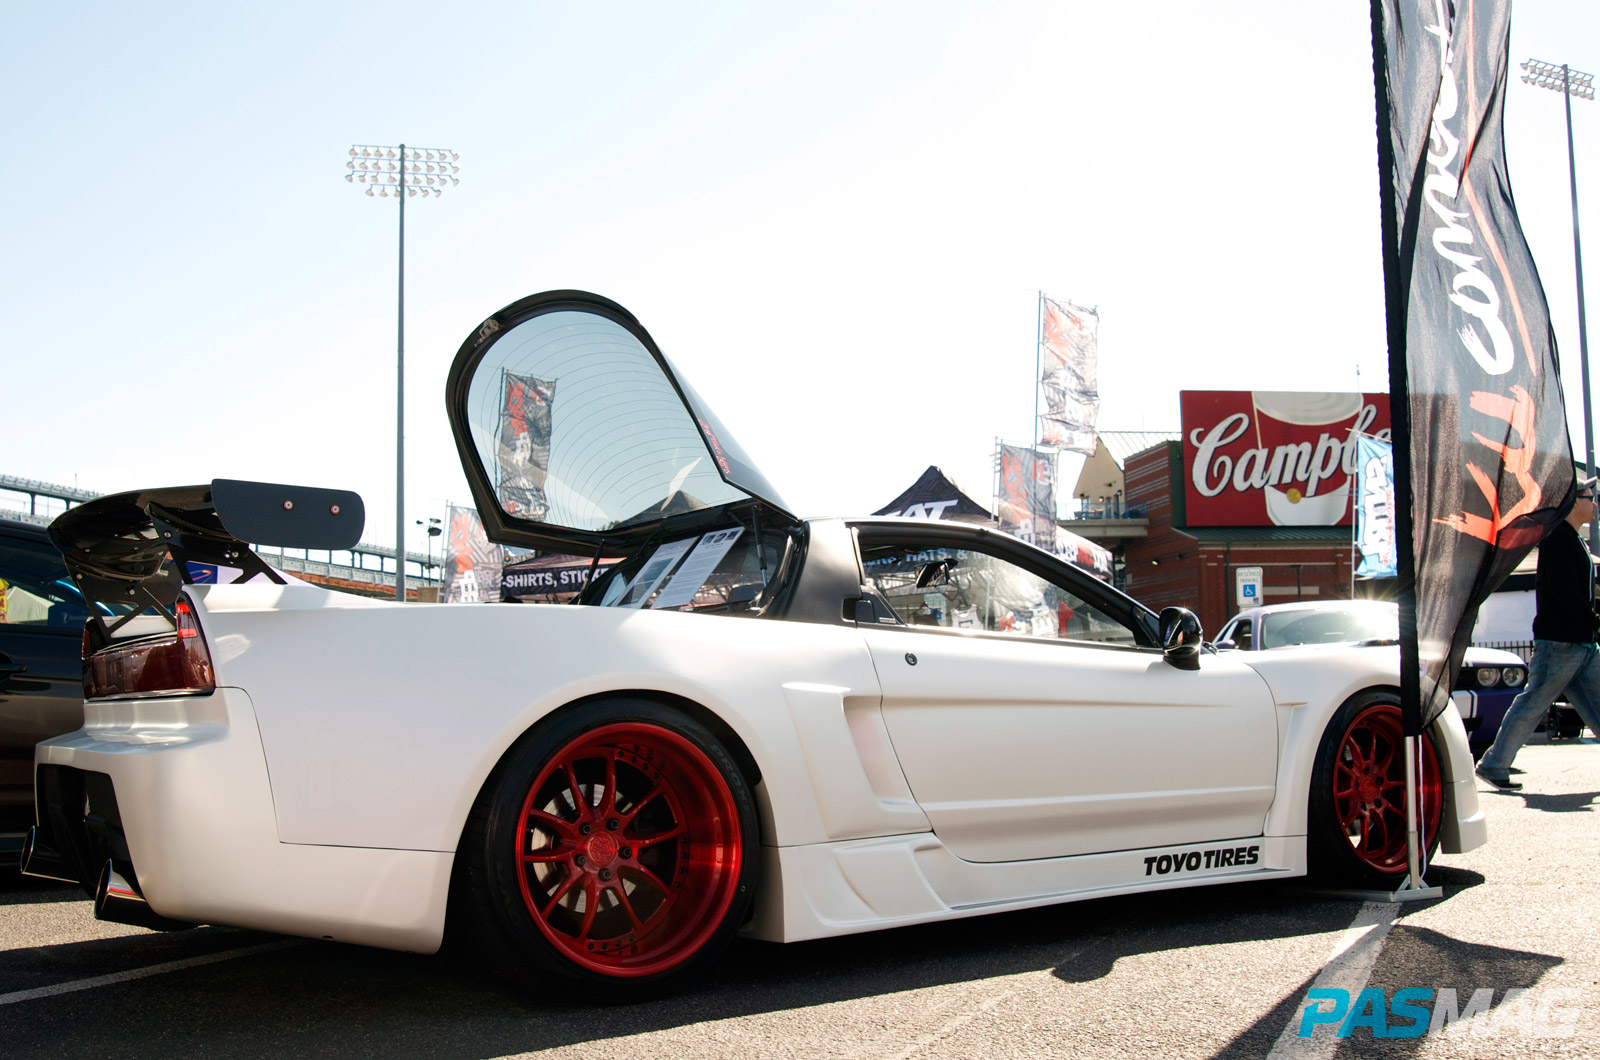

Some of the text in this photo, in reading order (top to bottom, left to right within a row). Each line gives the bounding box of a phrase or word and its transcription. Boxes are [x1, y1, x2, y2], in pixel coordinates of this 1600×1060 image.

[884, 499, 959, 520] AT
[956, 549, 968, 560] &
[501, 573, 557, 588] -SHIRTS,
[1144, 845, 1260, 876] TOYO TIRES
